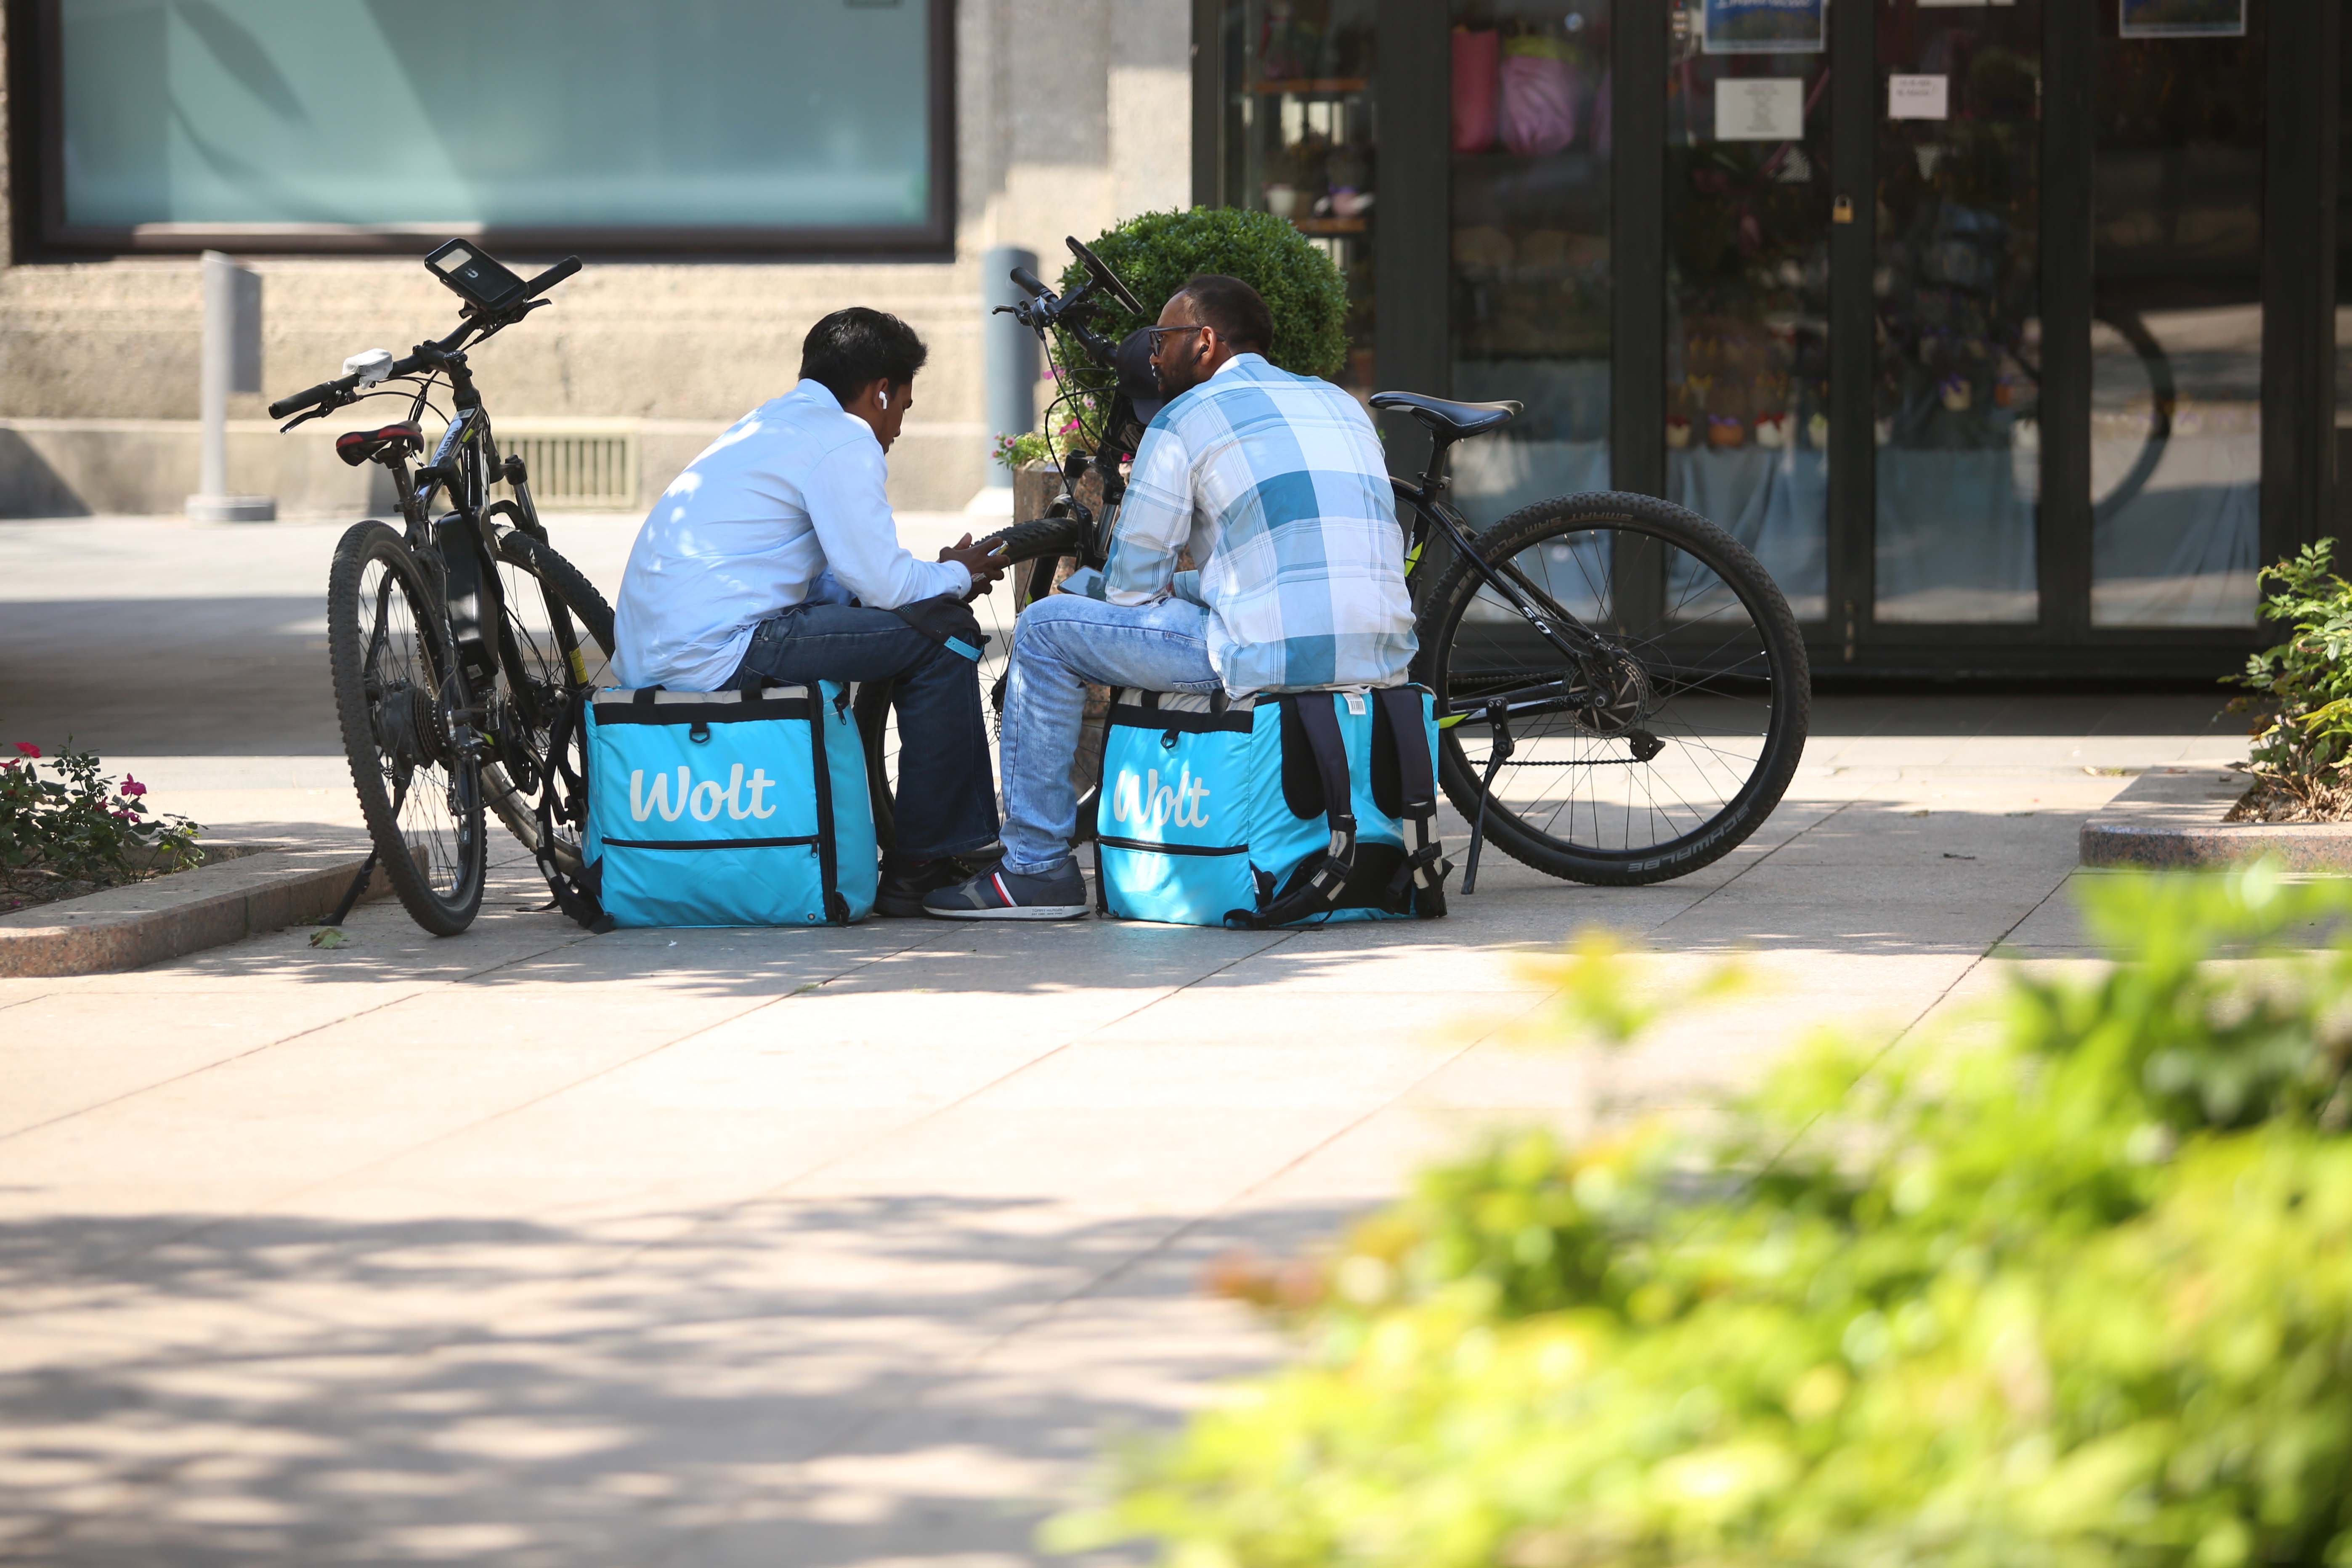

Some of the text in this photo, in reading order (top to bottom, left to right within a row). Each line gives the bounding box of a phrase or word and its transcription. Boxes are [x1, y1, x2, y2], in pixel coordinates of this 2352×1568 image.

[432, 427, 460, 467] EXAGON
[1484, 512, 1633, 562] SMART SAM PLUS
[1520, 607, 1551, 634] 5.0
[629, 763, 776, 822] Wolt
[1113, 768, 1210, 828] Wolt
[1627, 804, 1750, 872] SCHWALBE
